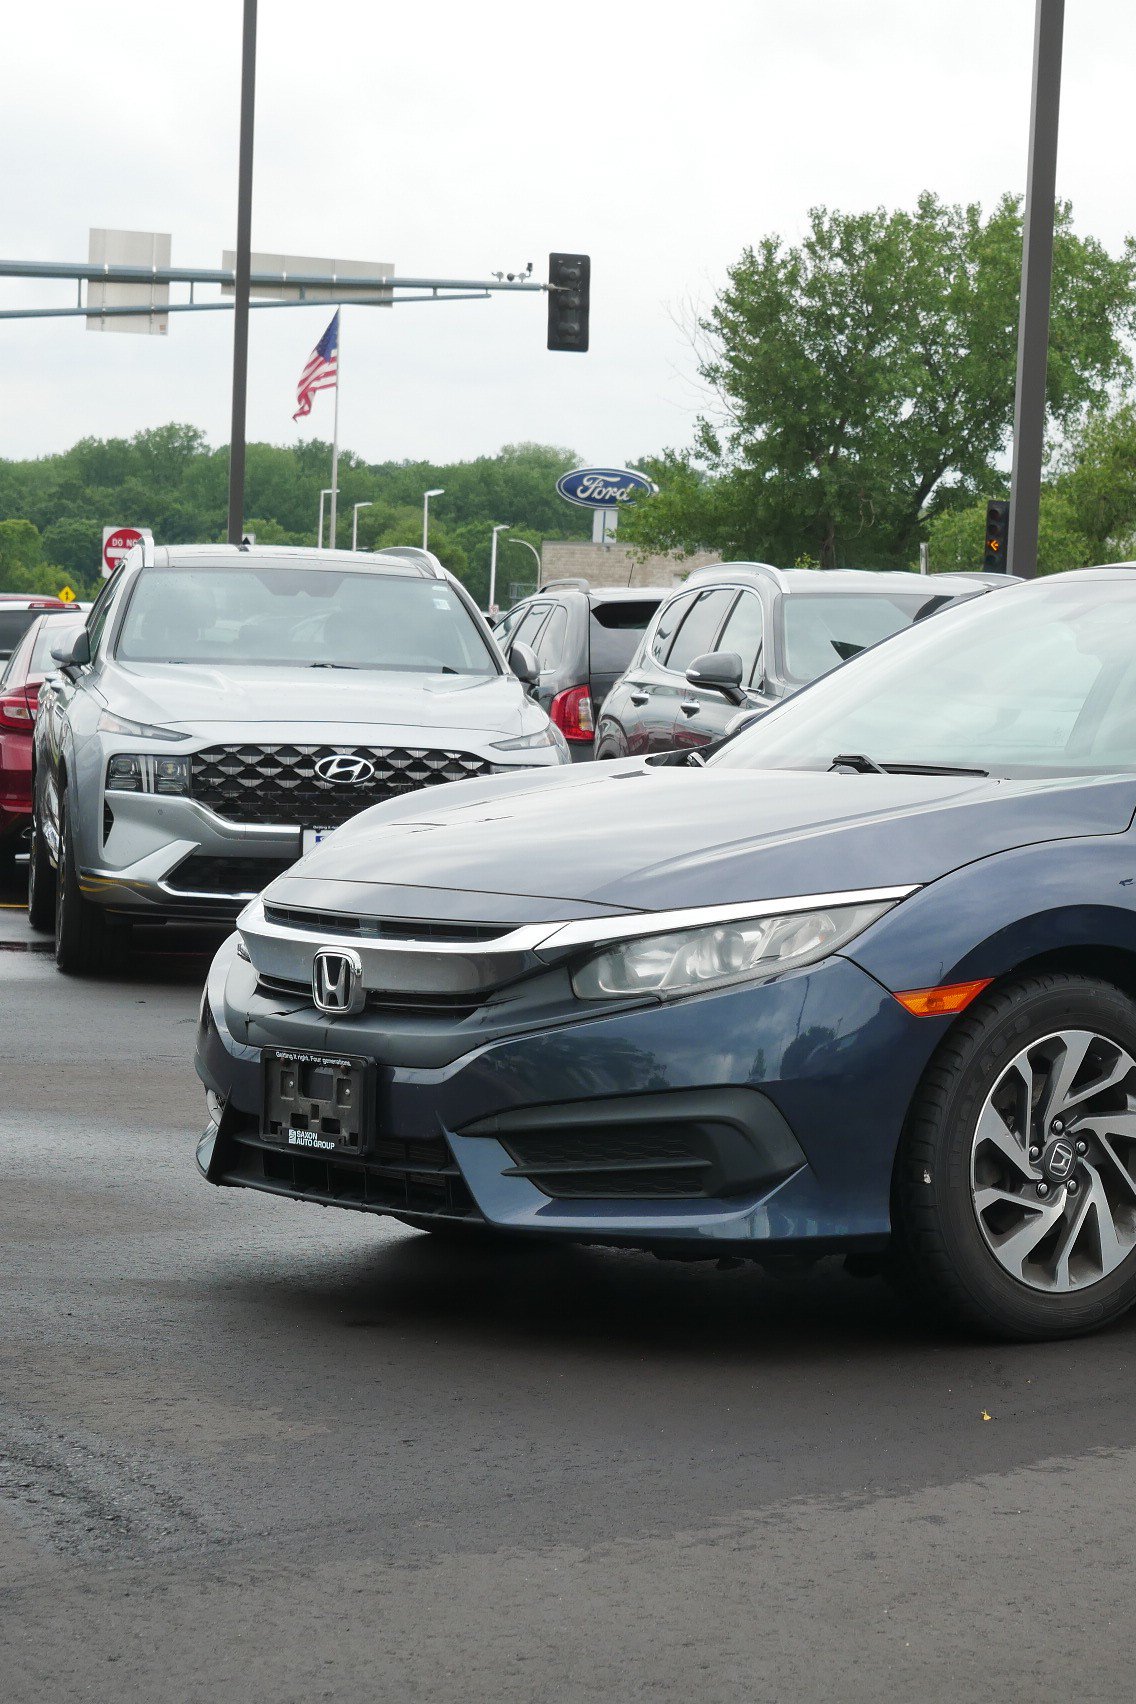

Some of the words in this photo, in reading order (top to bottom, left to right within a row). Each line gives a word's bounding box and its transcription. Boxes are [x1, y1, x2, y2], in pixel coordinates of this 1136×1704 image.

[576, 474, 635, 500] Ford
[112, 538, 123, 547] DO
[126, 538, 138, 547] NO
[296, 1130, 318, 1141] SAXON
[296, 1137, 313, 1147] AUTO
[313, 1140, 336, 1150] GROUP
